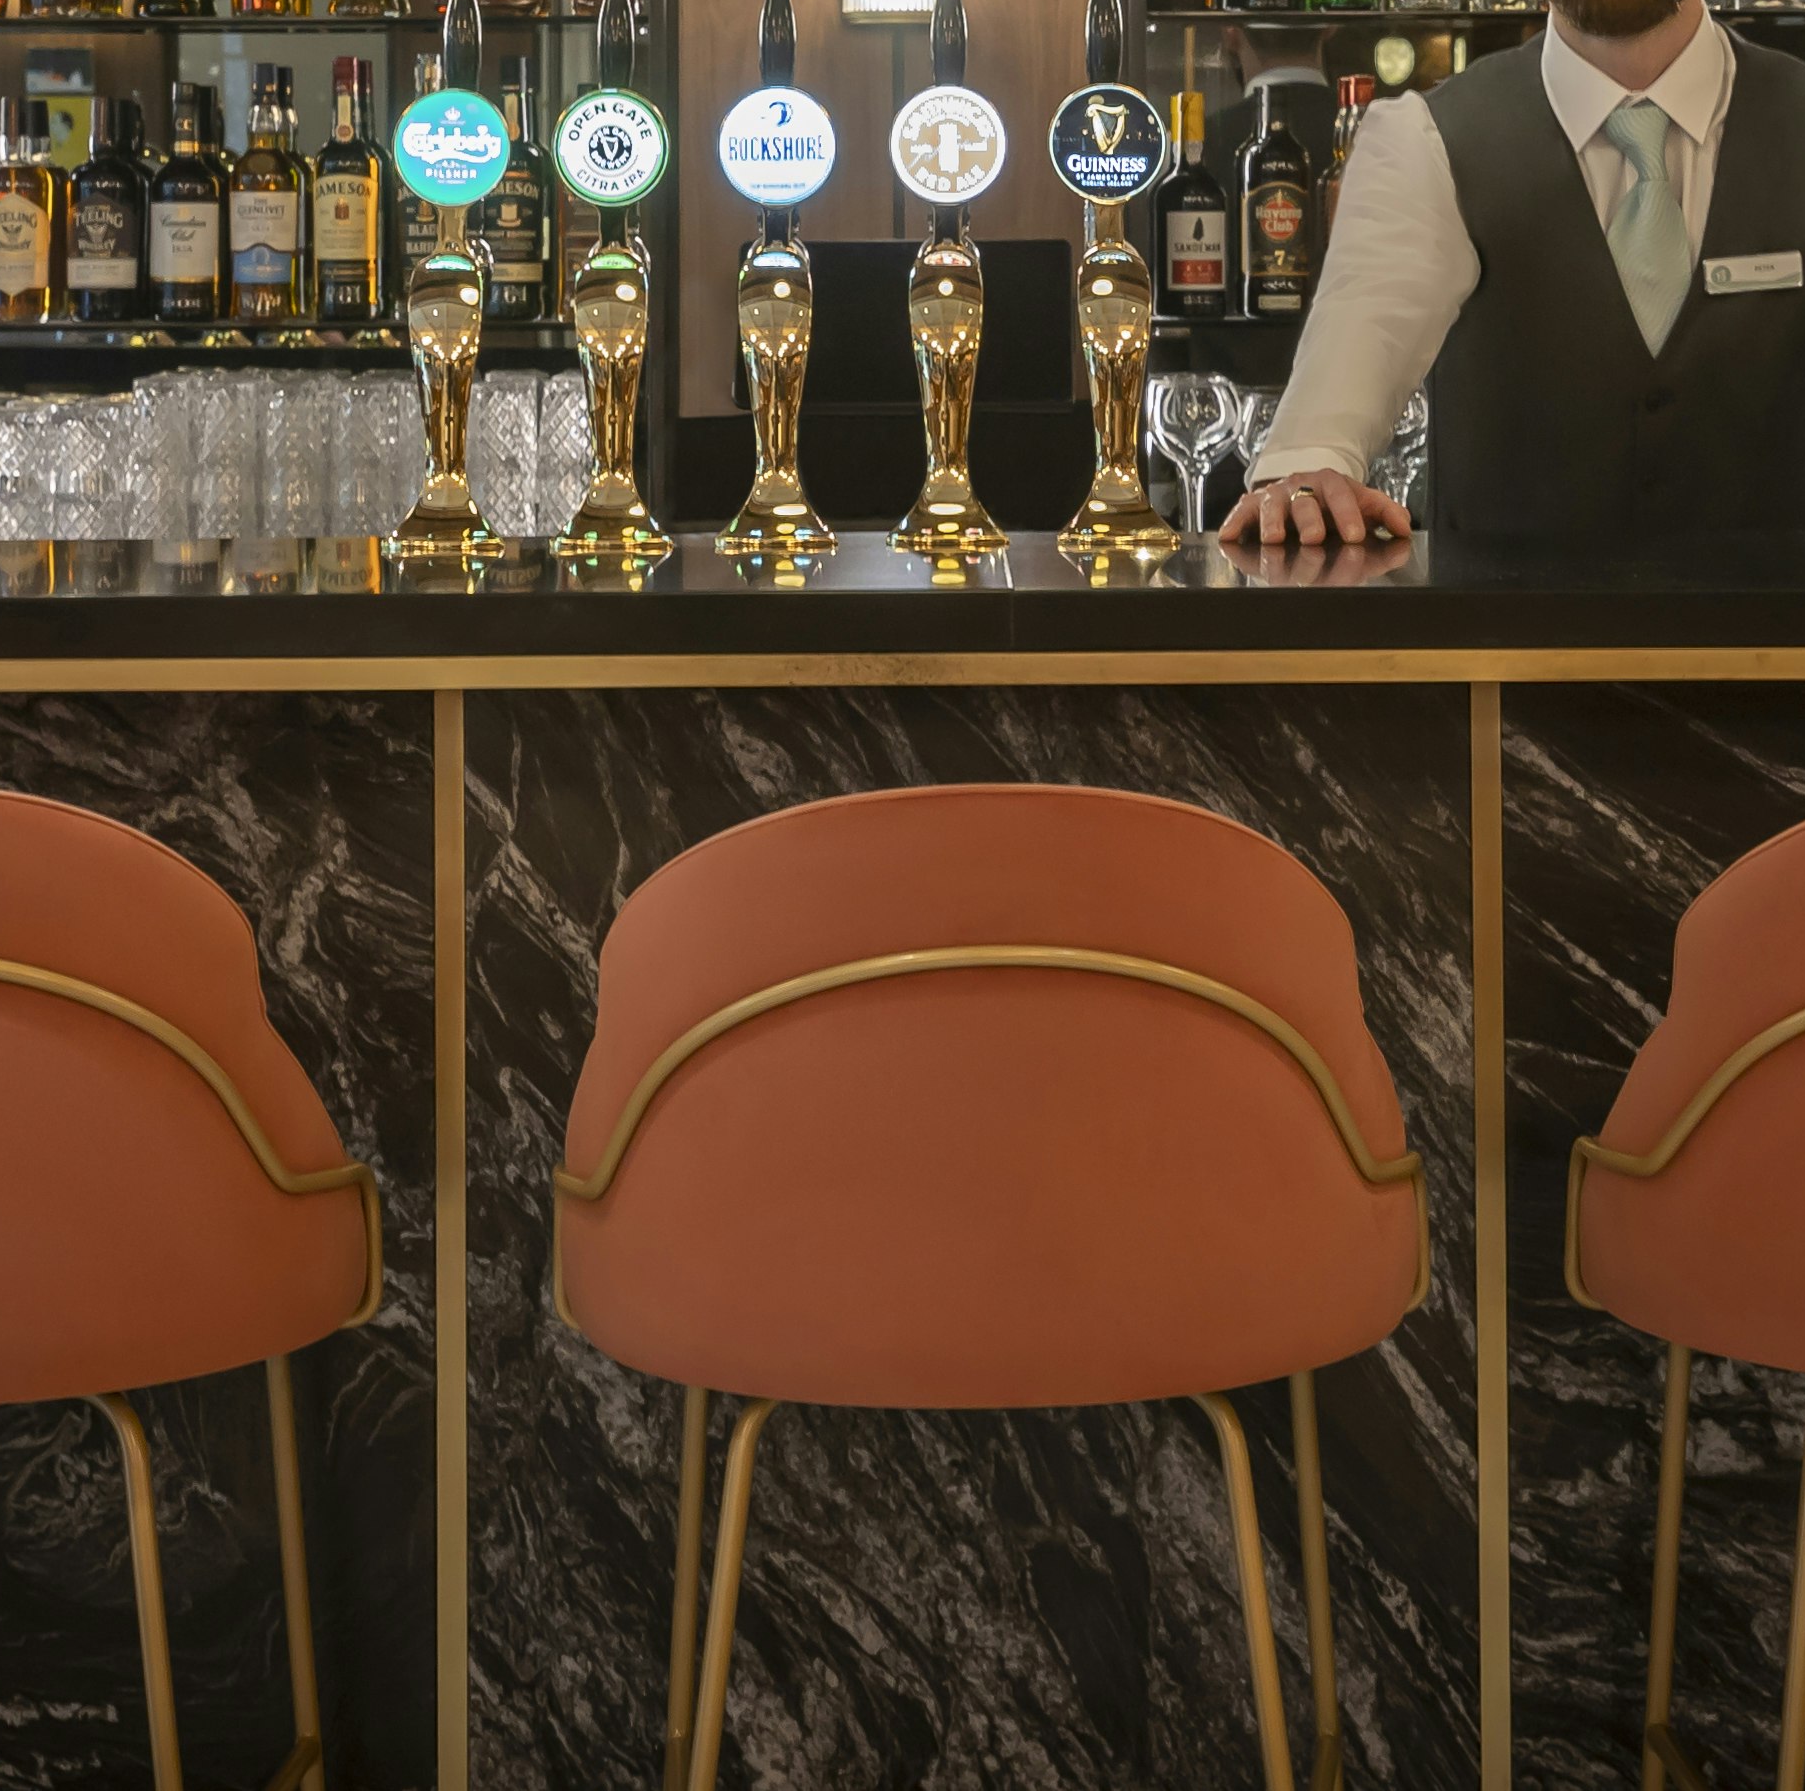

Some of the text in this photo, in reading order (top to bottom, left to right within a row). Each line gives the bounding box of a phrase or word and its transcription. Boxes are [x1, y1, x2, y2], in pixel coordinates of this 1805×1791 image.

[569, 102, 653, 142] OPEN GATE
[728, 134, 826, 162] ROCKSHORE
[1066, 153, 1148, 173] GUINNESS
[576, 168, 646, 191] CITRA IPA
[73, 211, 124, 229] TEELING
[1264, 219, 1294, 233] Club
[407, 223, 437, 237] BLAC
[1274, 250, 1286, 266] 7
